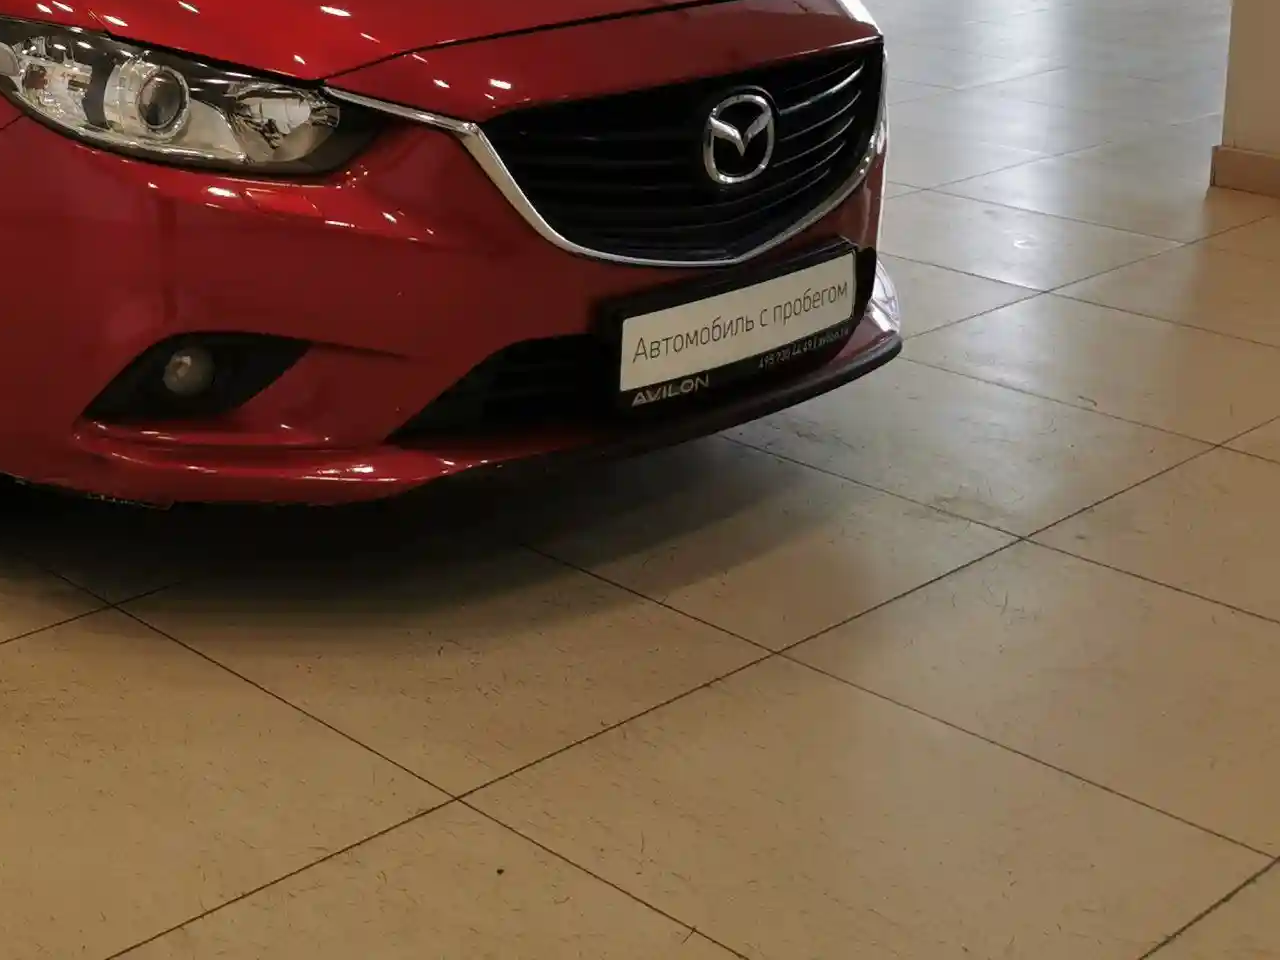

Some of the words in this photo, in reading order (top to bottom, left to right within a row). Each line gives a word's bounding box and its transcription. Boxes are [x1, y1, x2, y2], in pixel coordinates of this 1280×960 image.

[632, 315, 755, 364] Автомобиль
[759, 308, 768, 327] с
[773, 281, 849, 326] пробегом
[631, 374, 709, 407] AVILON
